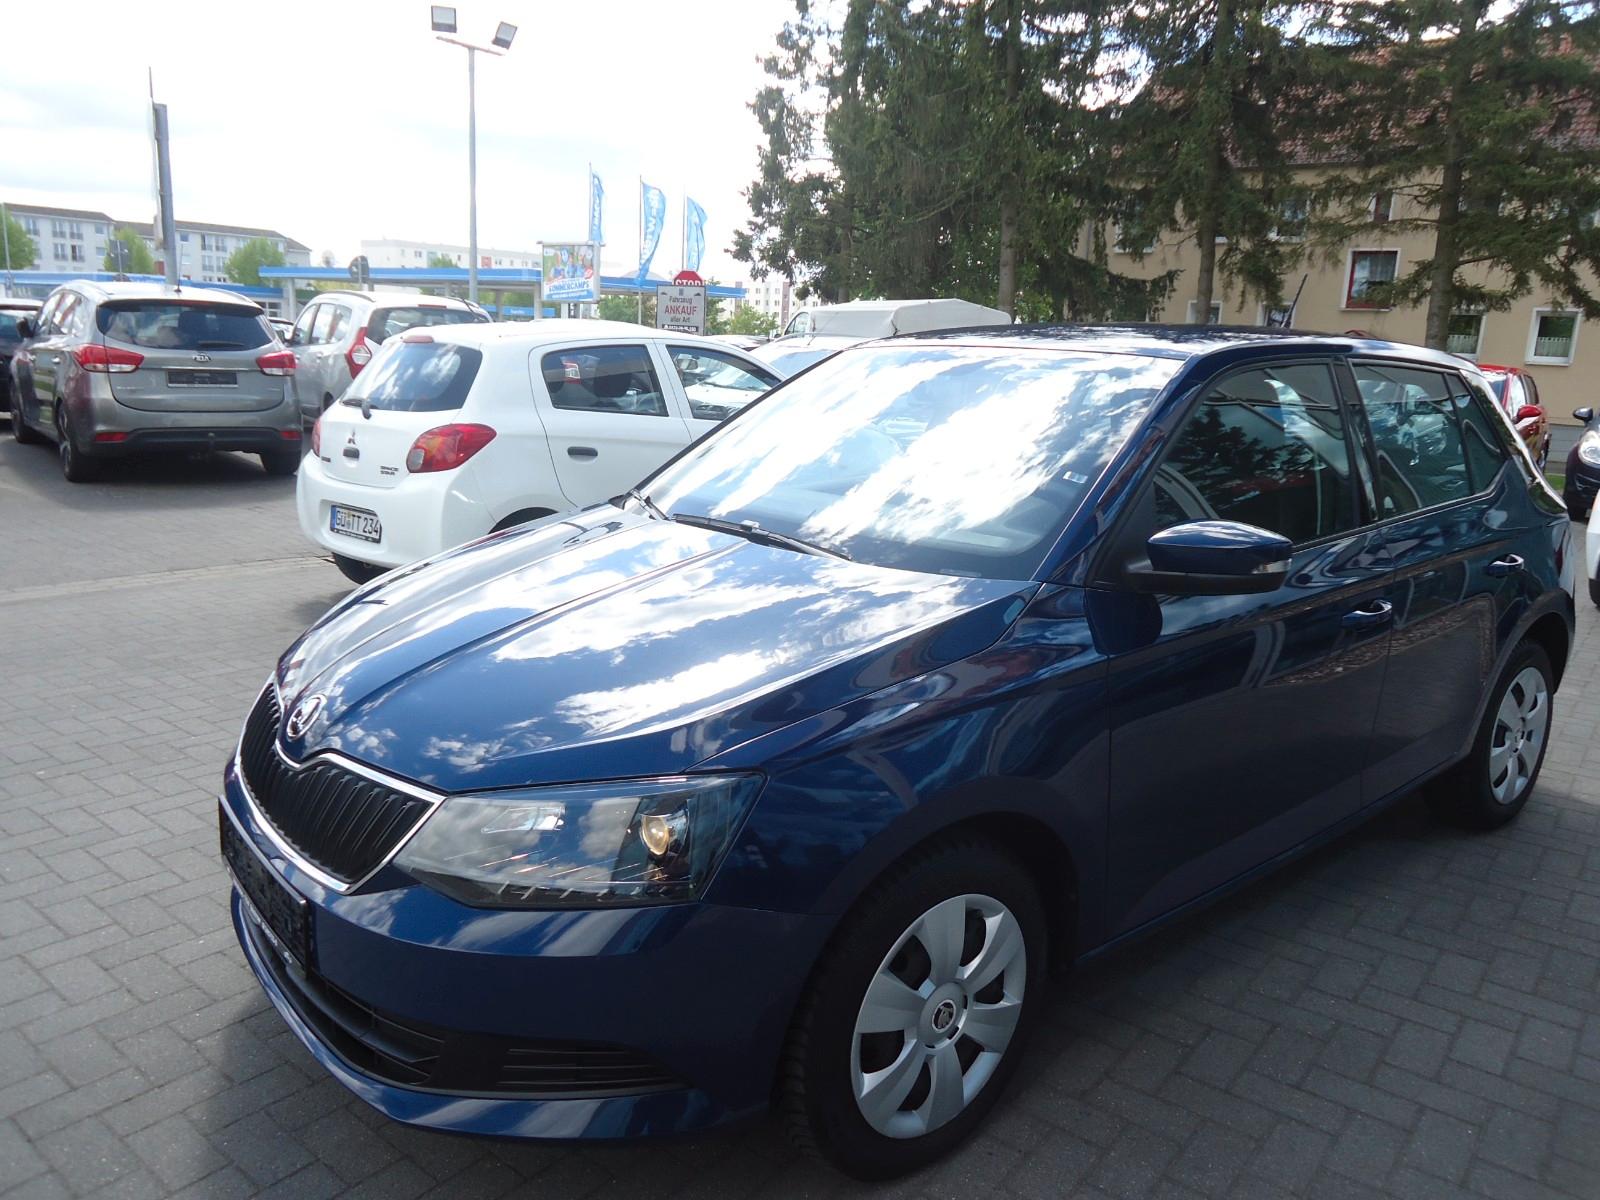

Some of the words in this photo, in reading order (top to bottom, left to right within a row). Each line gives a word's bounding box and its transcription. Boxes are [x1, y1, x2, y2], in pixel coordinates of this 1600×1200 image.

[669, 296, 693, 304] Fahrzeug
[665, 305, 697, 315] ANKAUF
[351, 513, 362, 532] TT
[362, 517, 379, 536] 234
